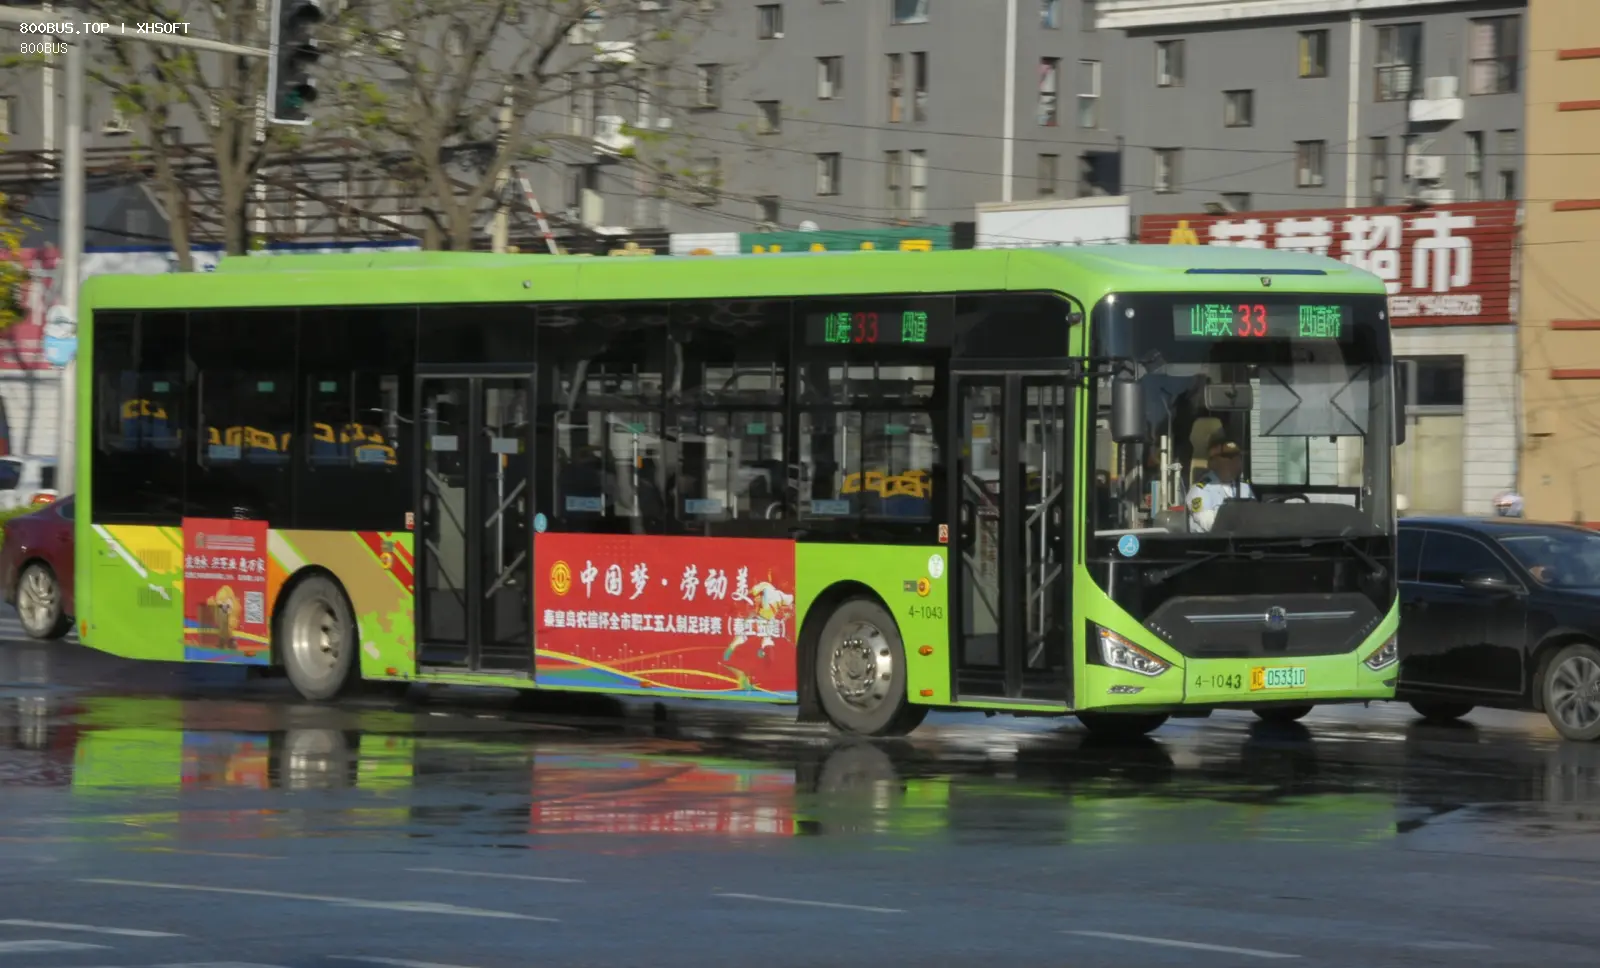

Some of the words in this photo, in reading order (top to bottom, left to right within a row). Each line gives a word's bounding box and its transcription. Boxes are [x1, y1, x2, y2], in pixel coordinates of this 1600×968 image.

[855, 311, 878, 343] 33
[1191, 304, 1233, 336] 山海关
[1238, 304, 1267, 337] 33
[1299, 305, 1341, 337] 四道桥
[908, 604, 943, 619] 4-1043
[1195, 673, 1242, 689] 4-1043
